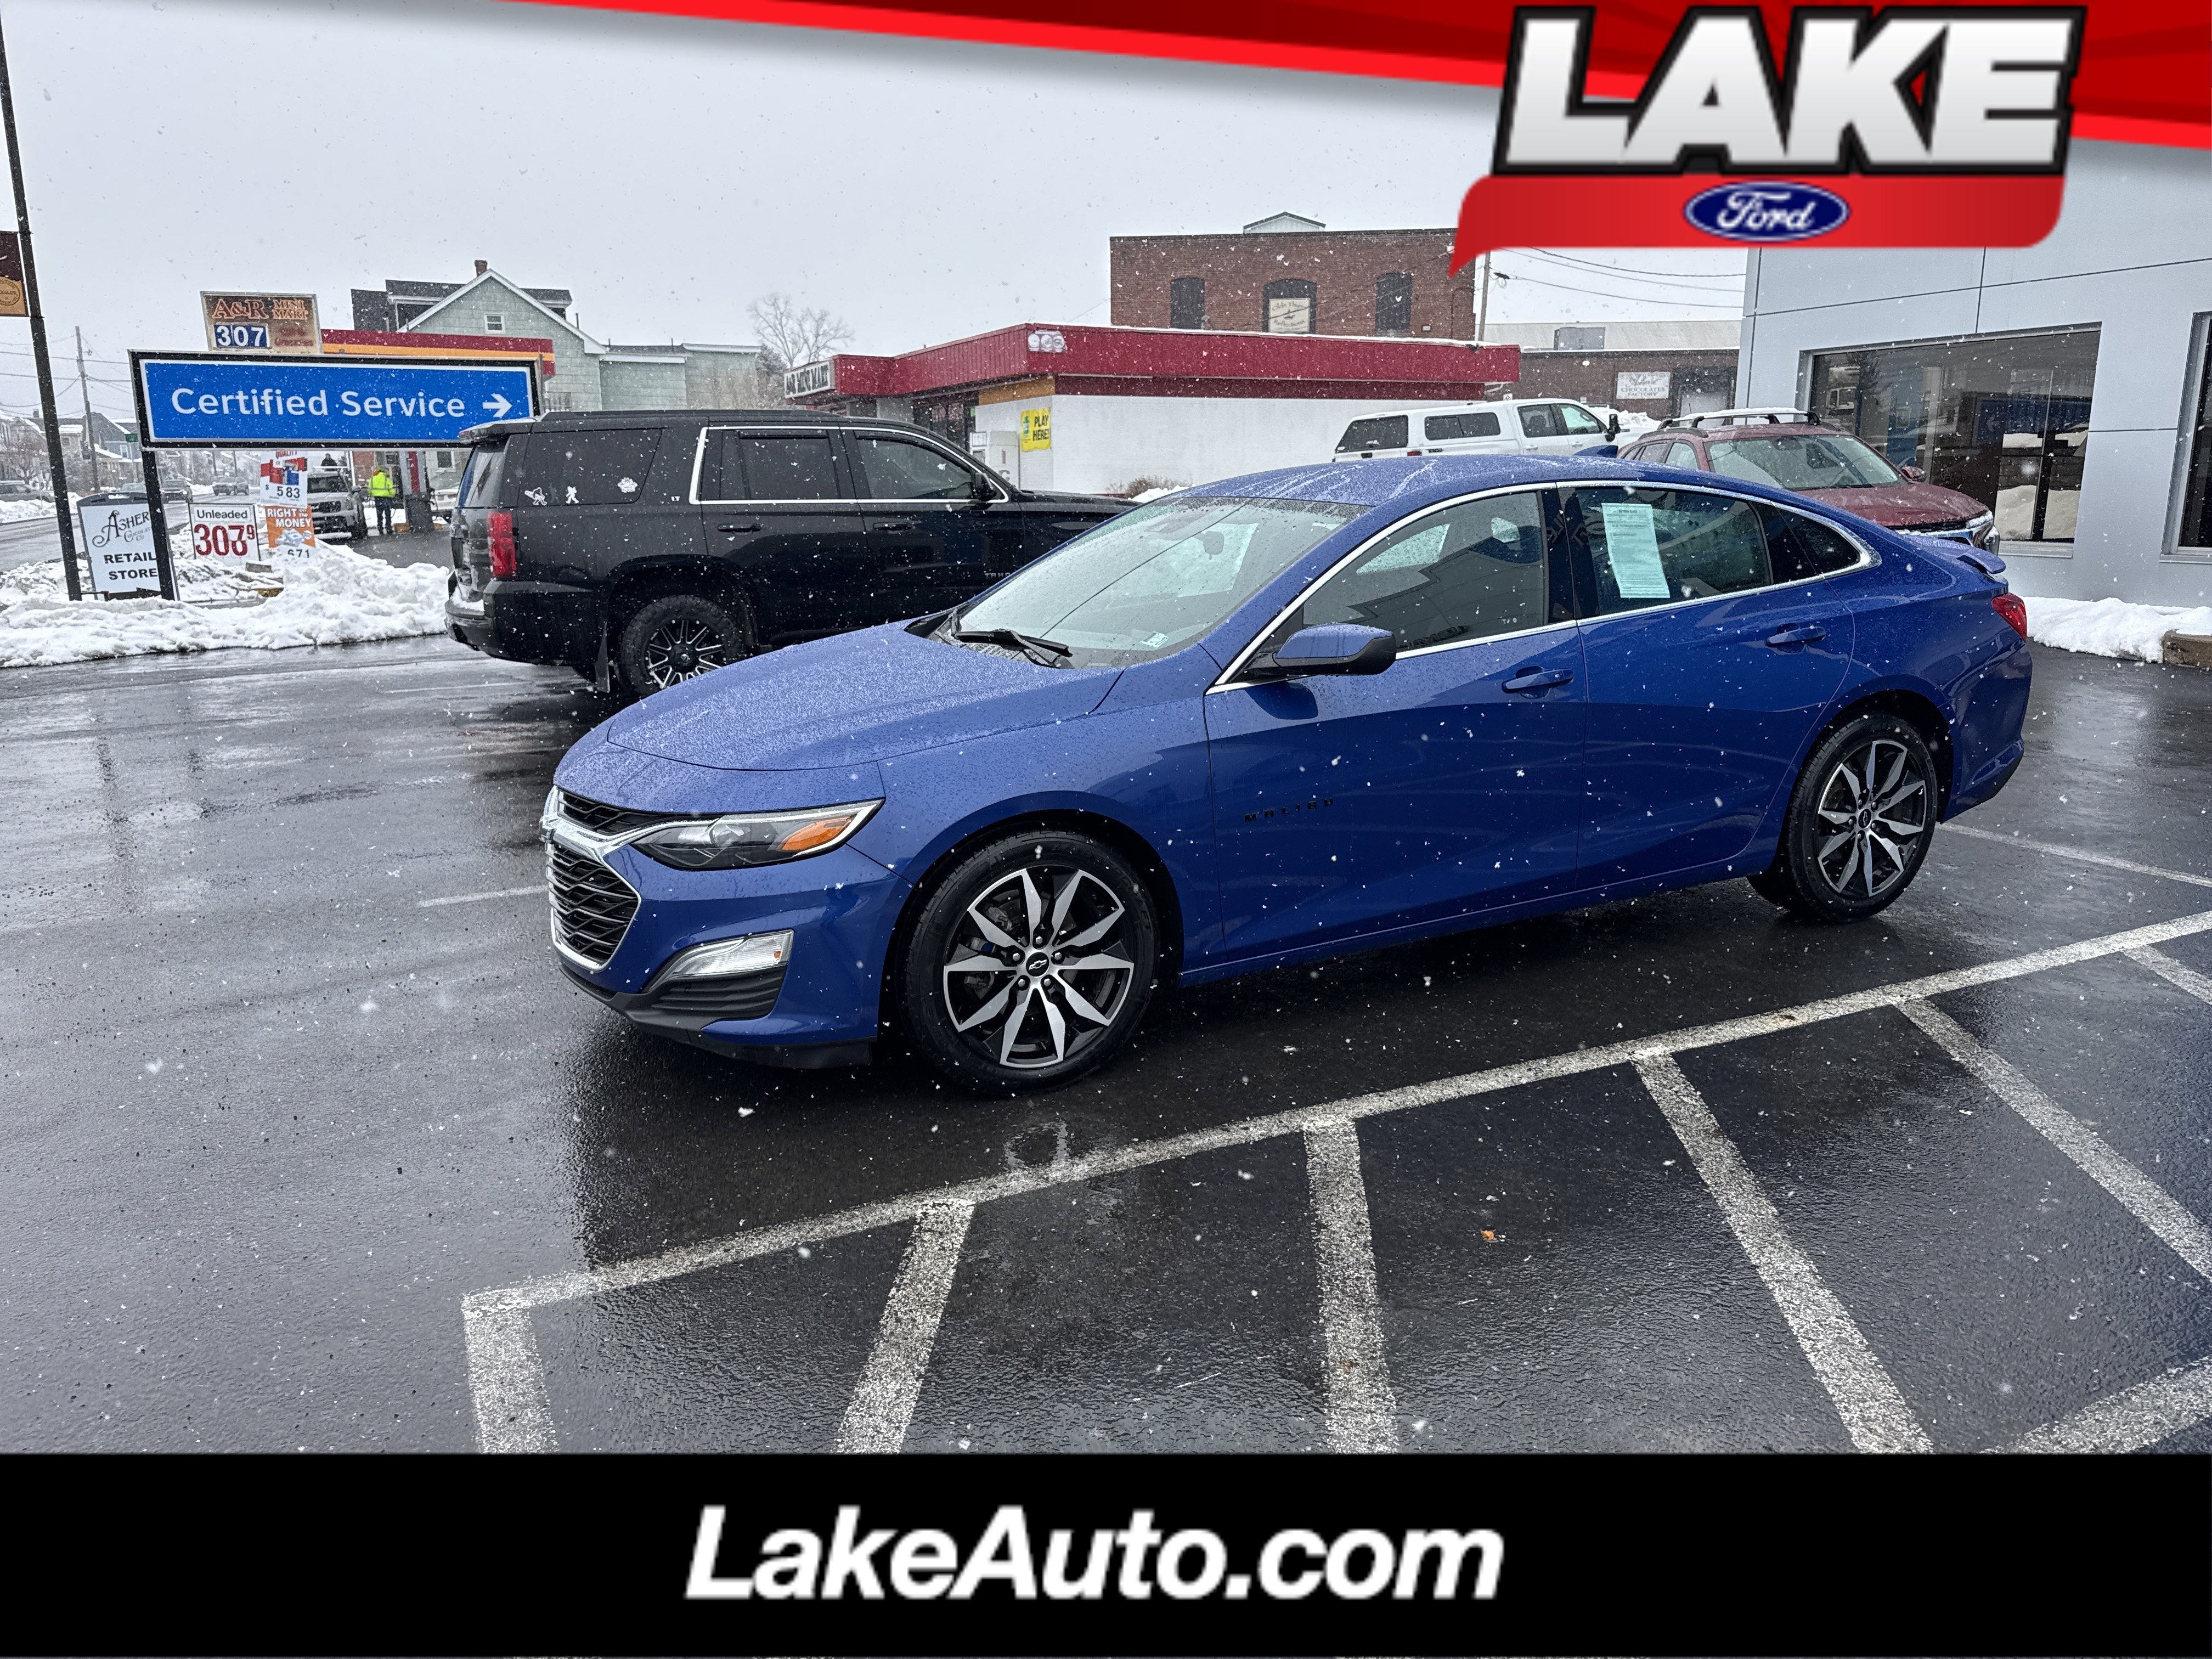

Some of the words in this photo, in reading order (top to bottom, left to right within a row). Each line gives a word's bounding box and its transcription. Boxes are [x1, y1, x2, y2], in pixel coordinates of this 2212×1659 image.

[212, 298, 269, 319] A&R
[274, 300, 306, 310] MINI
[273, 309, 309, 320] MART
[217, 325, 264, 347] 307
[171, 388, 328, 416] Certified
[342, 391, 465, 417] Service
[1034, 415, 1049, 428] PLAY
[196, 509, 248, 519] Unleaded
[267, 508, 297, 518] RIGHT
[275, 518, 311, 528] MONEY
[103, 552, 157, 564] RETAIL
[109, 568, 158, 580] STORE
